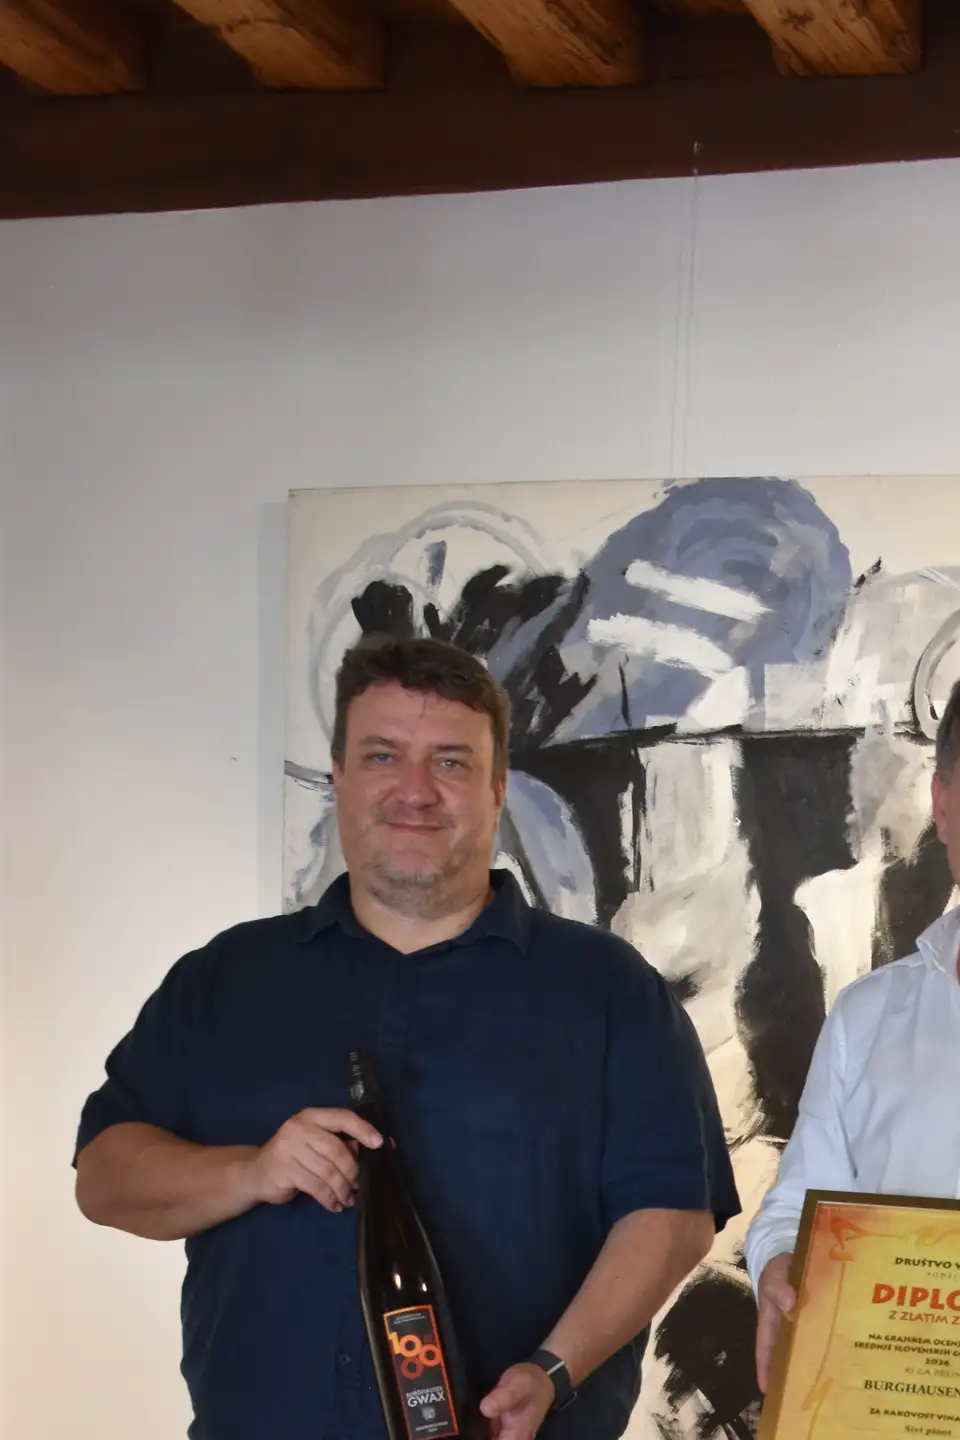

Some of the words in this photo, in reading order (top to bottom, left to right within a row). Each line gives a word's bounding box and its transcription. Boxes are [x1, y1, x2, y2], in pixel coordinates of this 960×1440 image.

[888, 1310, 898, 1320] Z
[901, 1311, 949, 1325] ZLATIM
[868, 1333, 882, 1342] NA
[407, 1391, 446, 1408] GWAX
[925, 1427, 952, 1437] pinot
